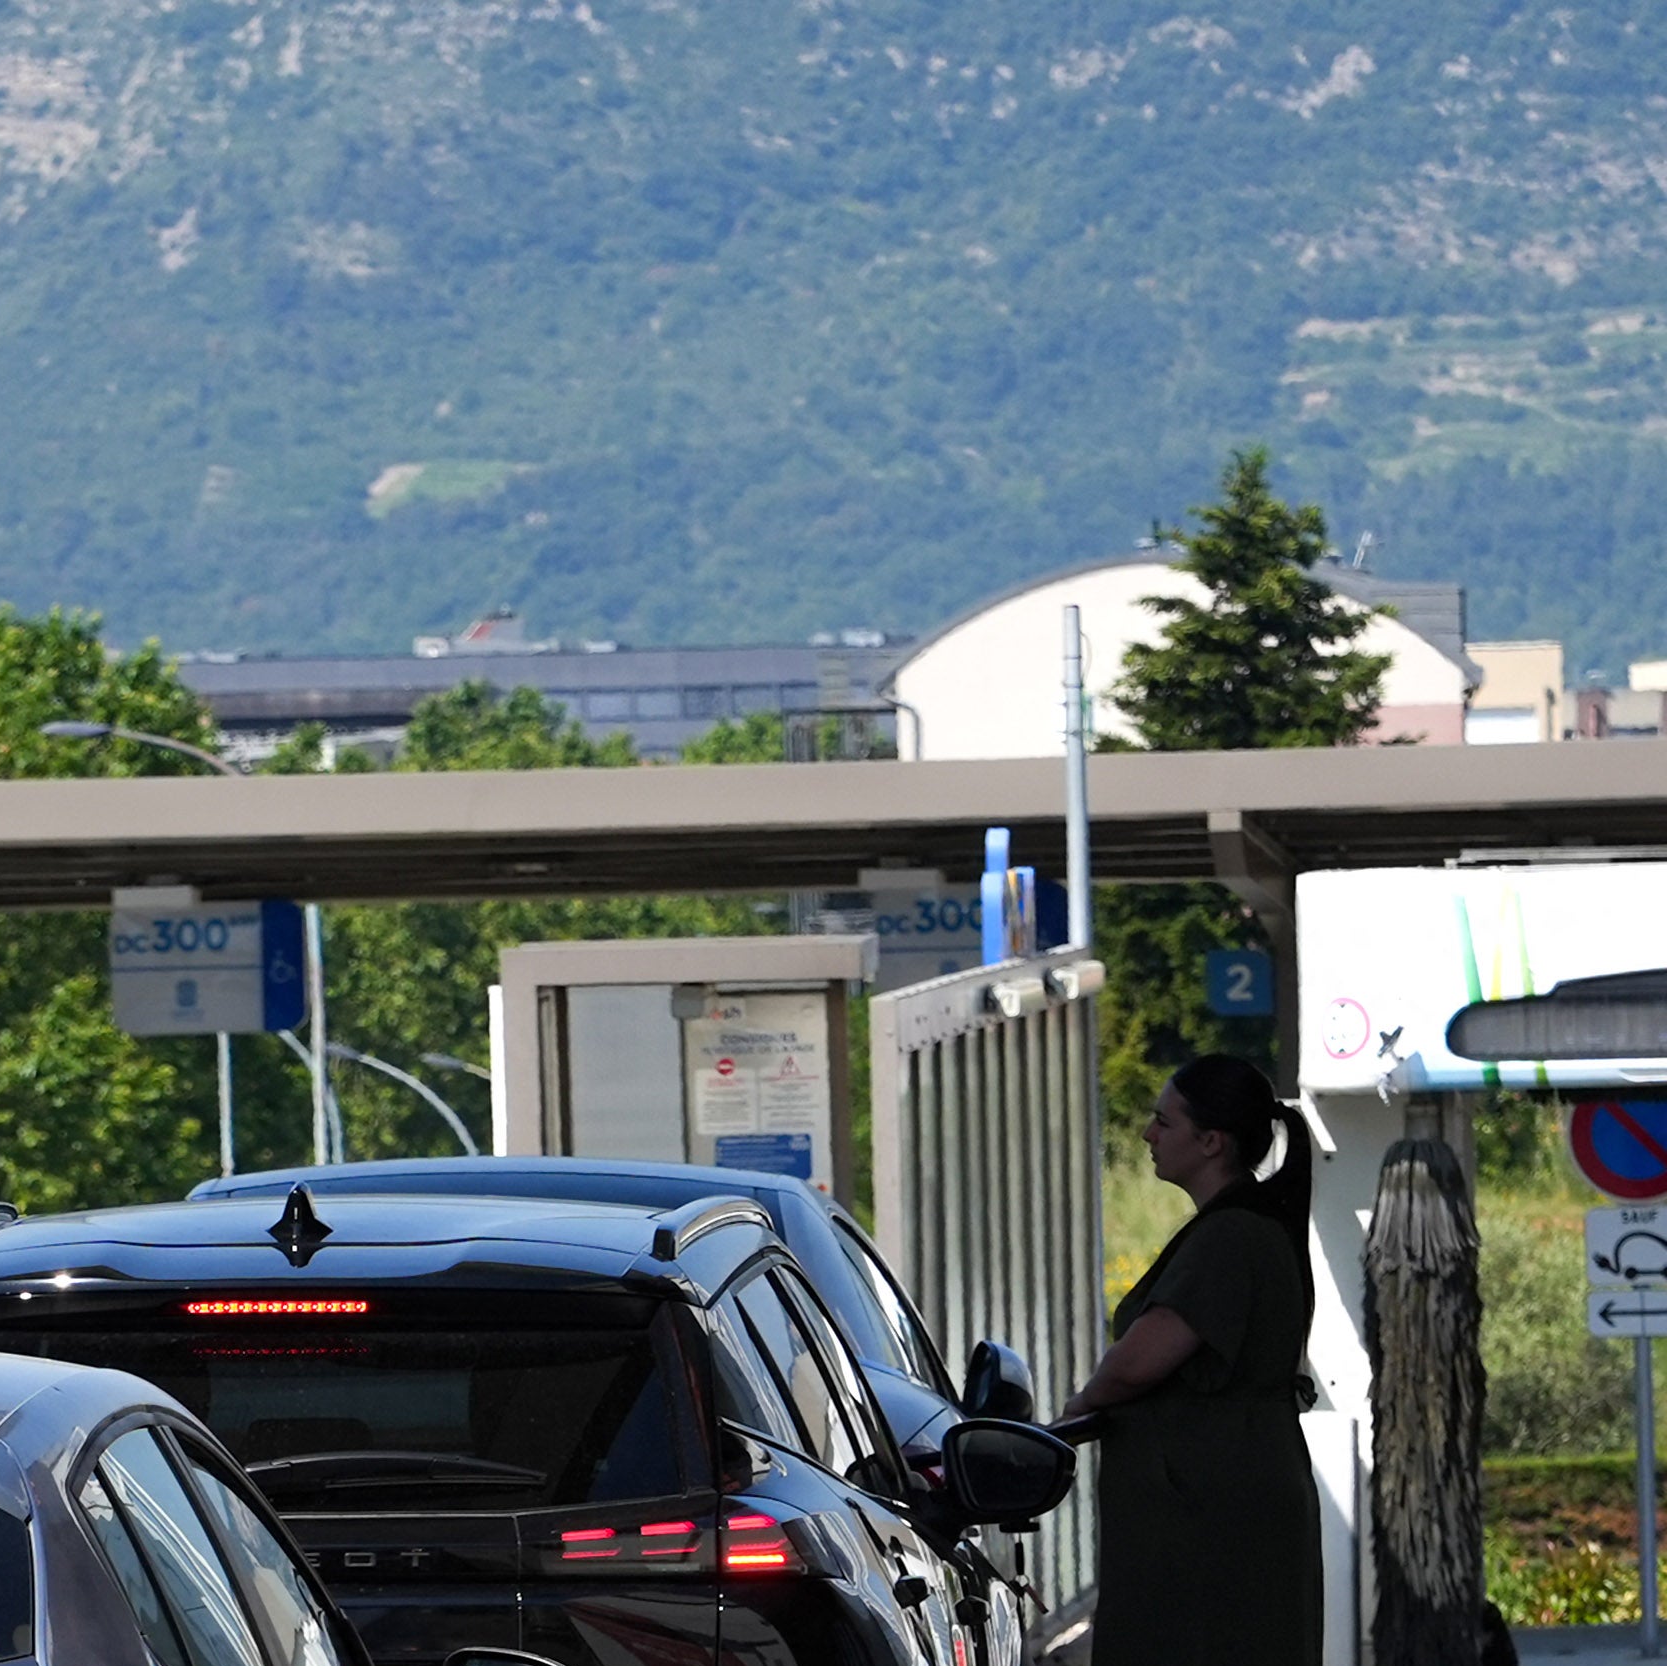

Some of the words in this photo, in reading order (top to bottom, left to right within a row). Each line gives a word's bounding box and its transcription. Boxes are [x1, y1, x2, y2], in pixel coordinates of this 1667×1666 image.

[152, 918, 228, 953] 300
[1226, 964, 1254, 1001] 2
[304, 1548, 431, 1568] EOT
